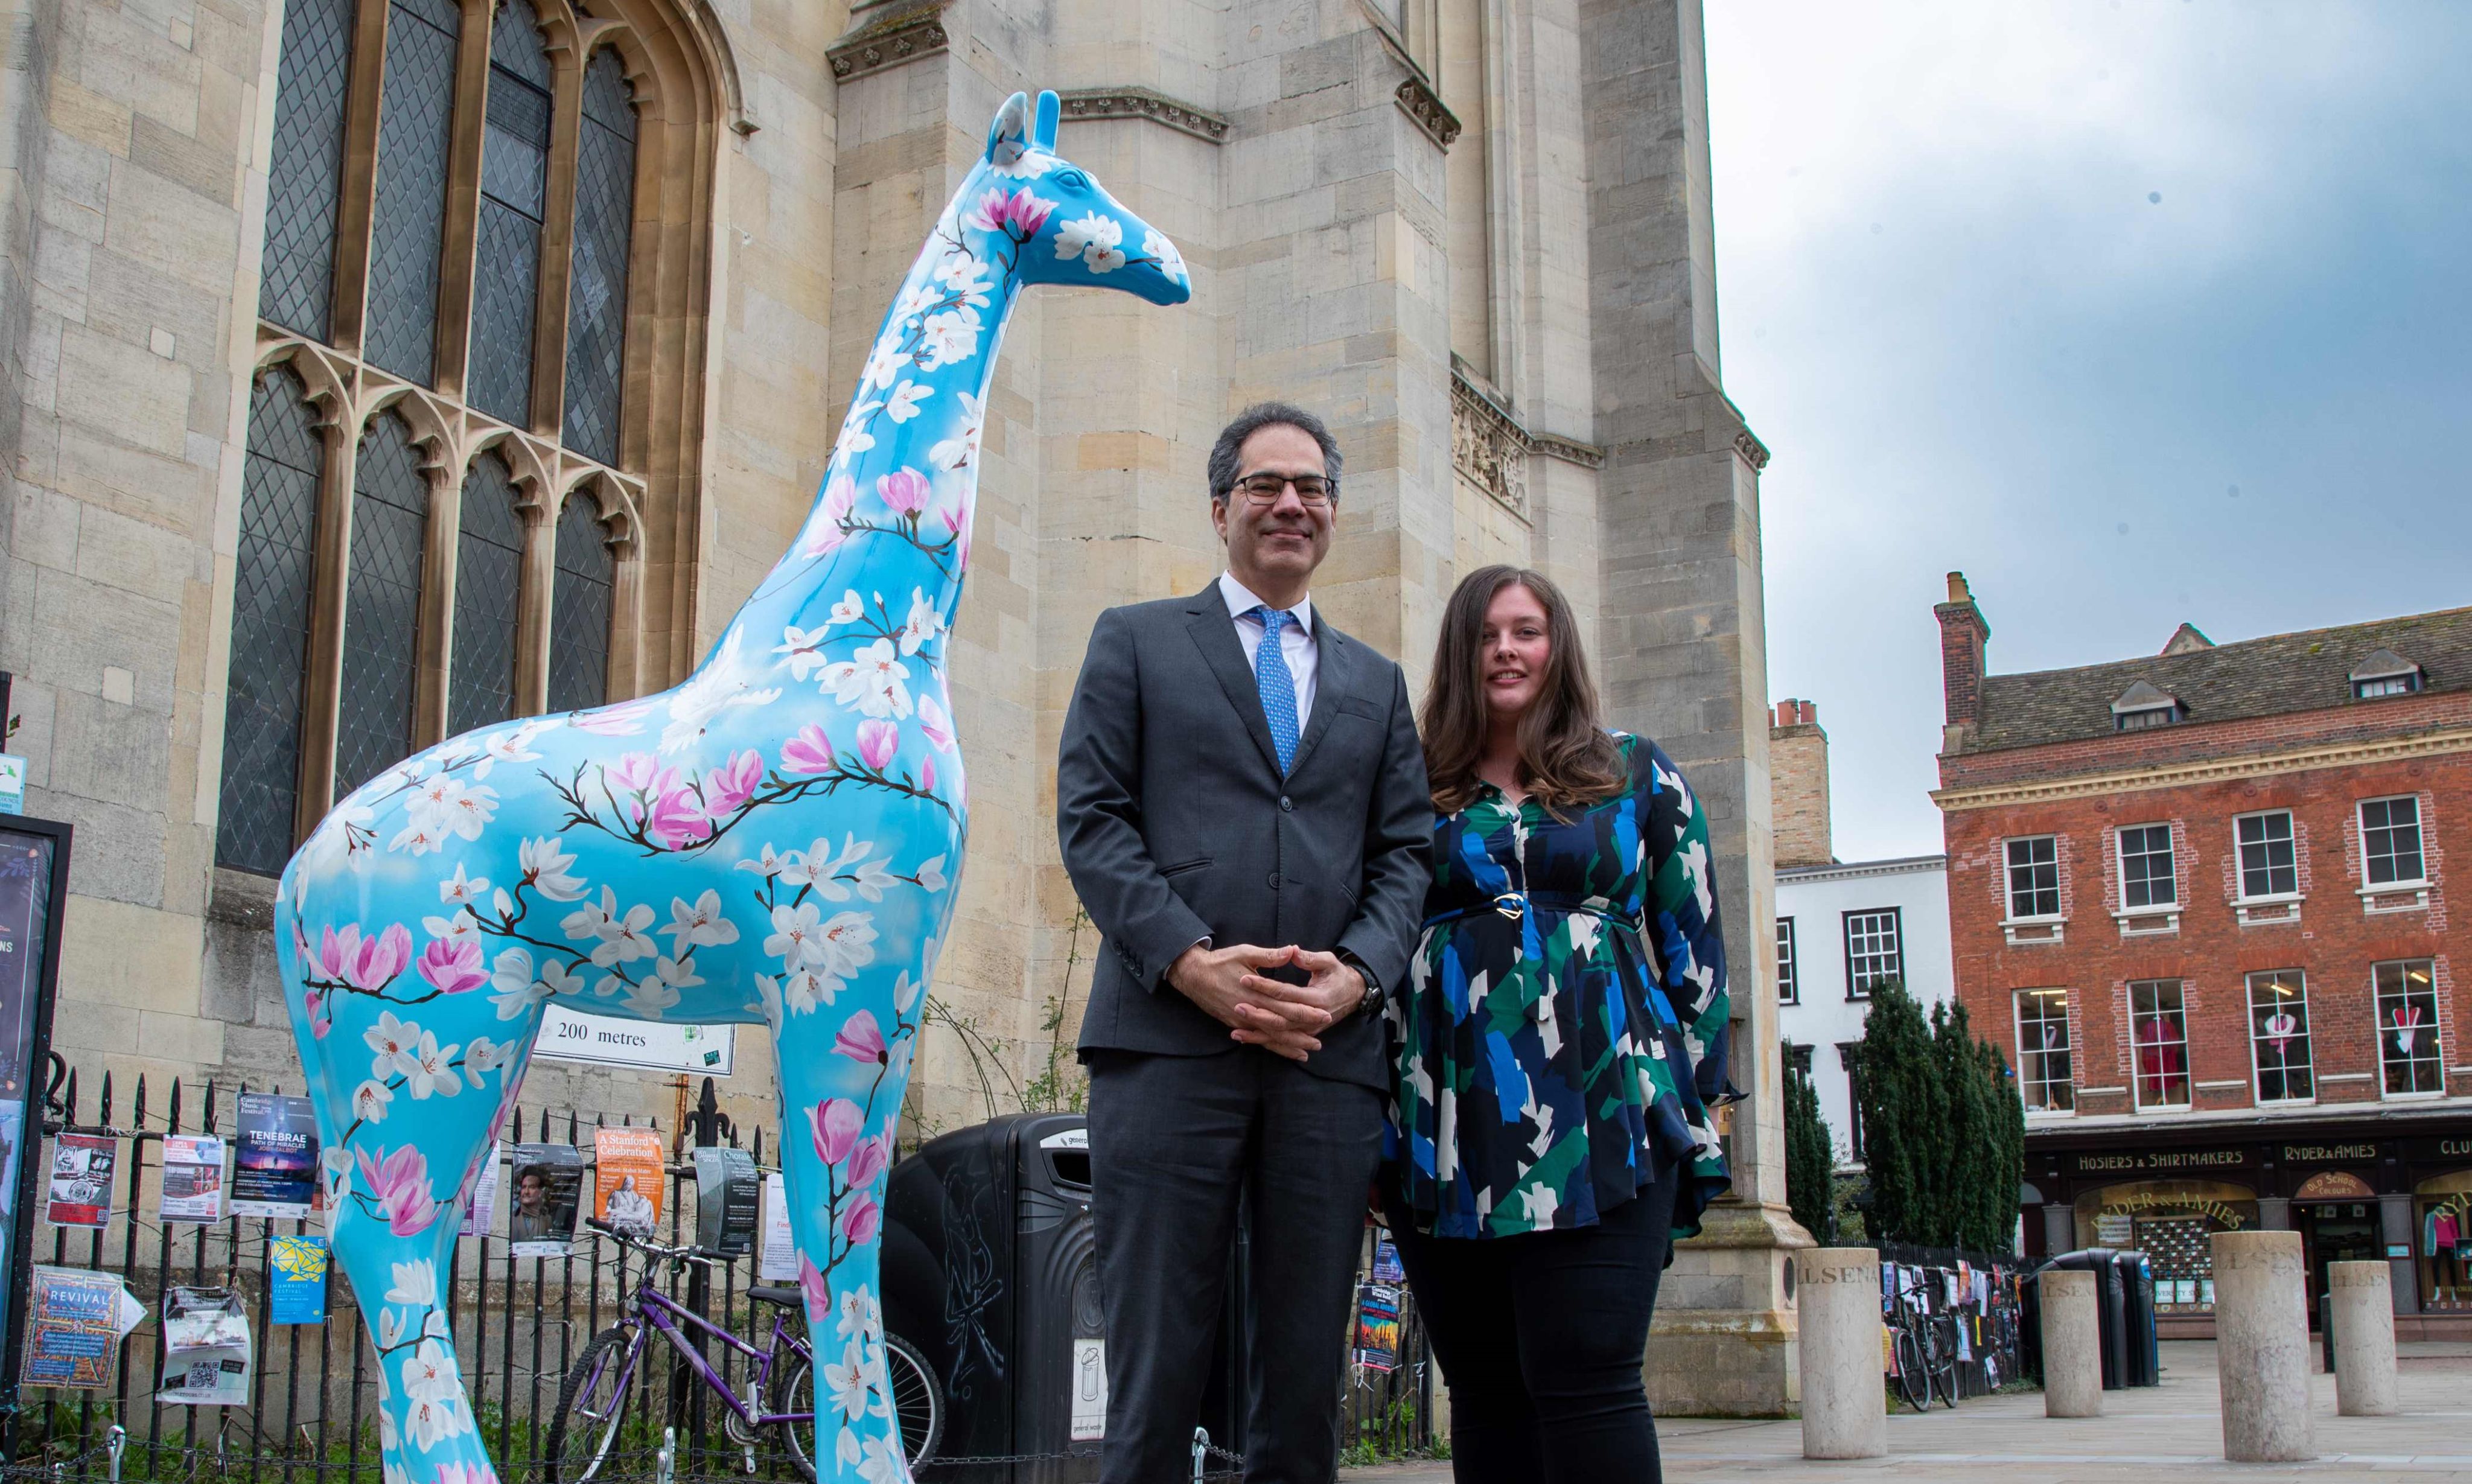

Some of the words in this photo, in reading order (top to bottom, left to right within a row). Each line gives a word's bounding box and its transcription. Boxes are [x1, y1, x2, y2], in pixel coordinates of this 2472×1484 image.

[558, 1022, 587, 1040] 200
[598, 1030, 646, 1047] metres
[250, 1130, 307, 1144] TENEBRAE
[599, 1135, 607, 1144] A
[610, 1135, 649, 1147] Stanford
[600, 1145, 654, 1158] Celebration
[2441, 1140, 2472, 1154] CLU
[724, 1150, 751, 1162] Chorale
[2080, 1156, 2133, 1170] HOSIERS
[2149, 1151, 2243, 1167] SHIRTMAKERS
[2307, 1180, 2323, 1192] OLD
[2326, 1175, 2357, 1189] SCHOOL
[2091, 1191, 2157, 1231] RYDER
[2159, 1196, 2173, 1206] &
[2176, 1191, 2246, 1231] AMIES
[2433, 1189, 2472, 1223] RYD
[50, 1290, 107, 1305] REVIVAL
